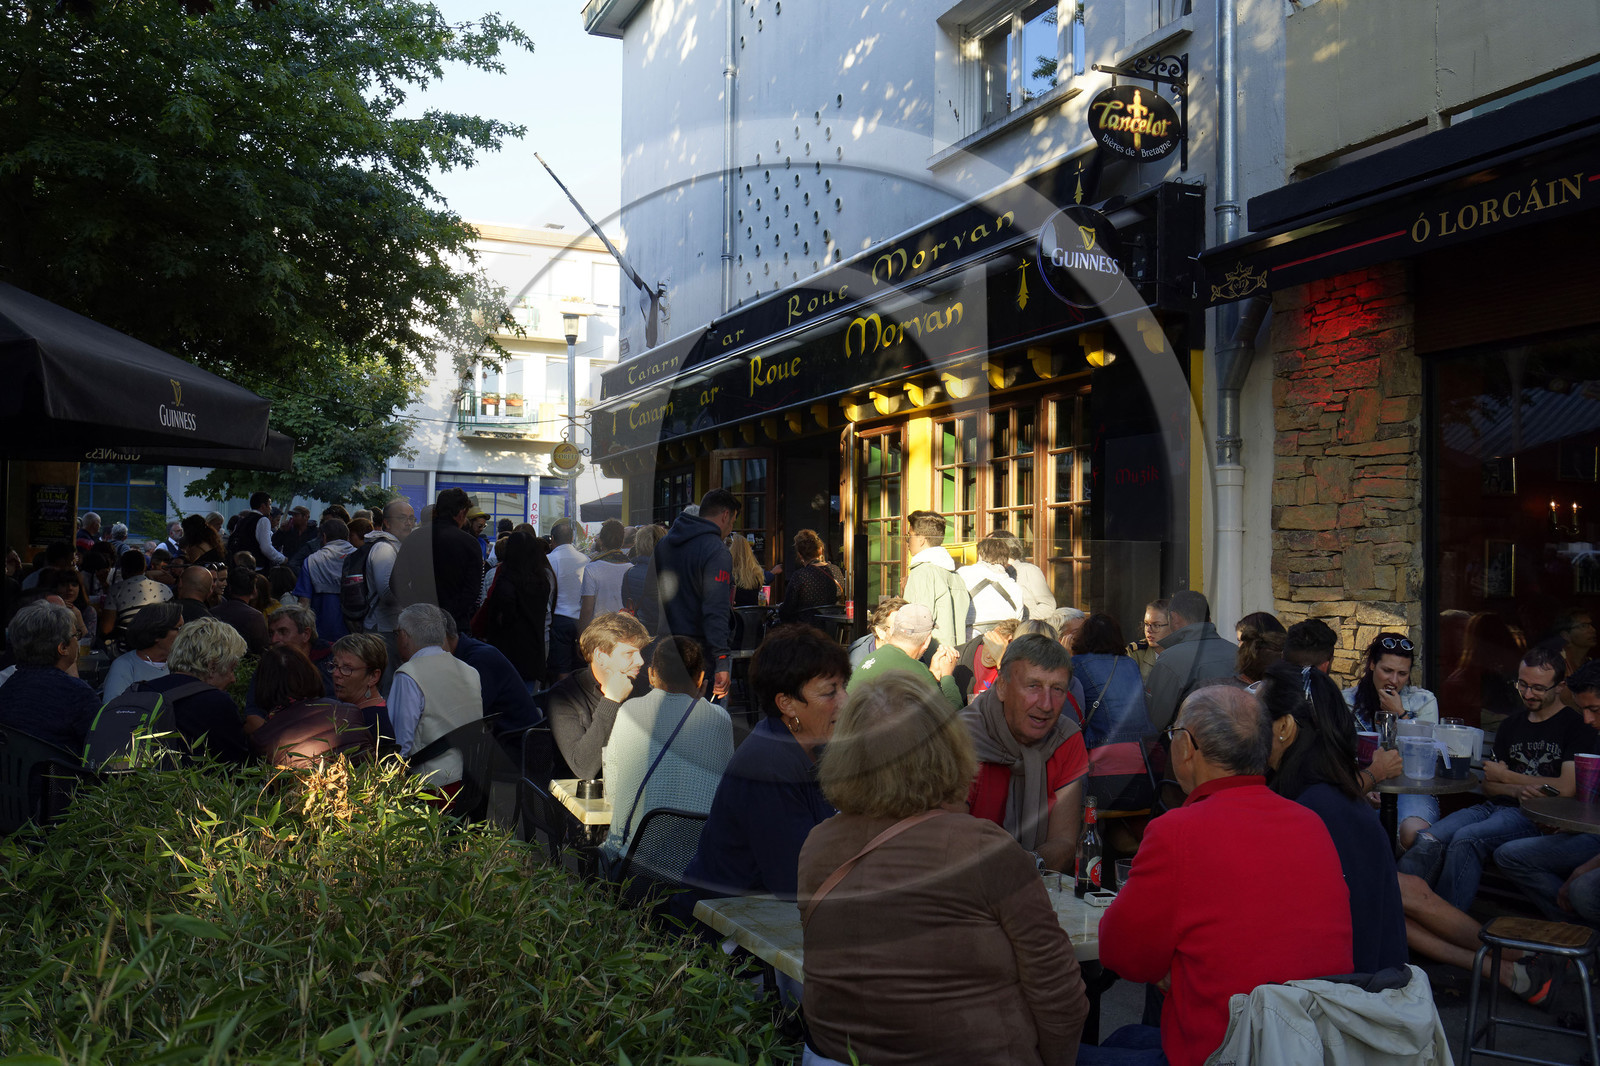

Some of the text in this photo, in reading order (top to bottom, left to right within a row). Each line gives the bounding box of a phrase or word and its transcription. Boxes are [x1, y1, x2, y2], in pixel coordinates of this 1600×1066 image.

[1092, 100, 1171, 137] Lancelot
[1102, 133, 1172, 158] Bières de Bretagne
[1411, 173, 1583, 244] Ó LORCÁIN
[1051, 247, 1120, 275] GUINNESS
[627, 210, 1015, 385] Tavarn ar Roue Morvan
[629, 301, 964, 430] Tavarn ar Roue Morvan
[159, 404, 197, 431] GUINNESS
